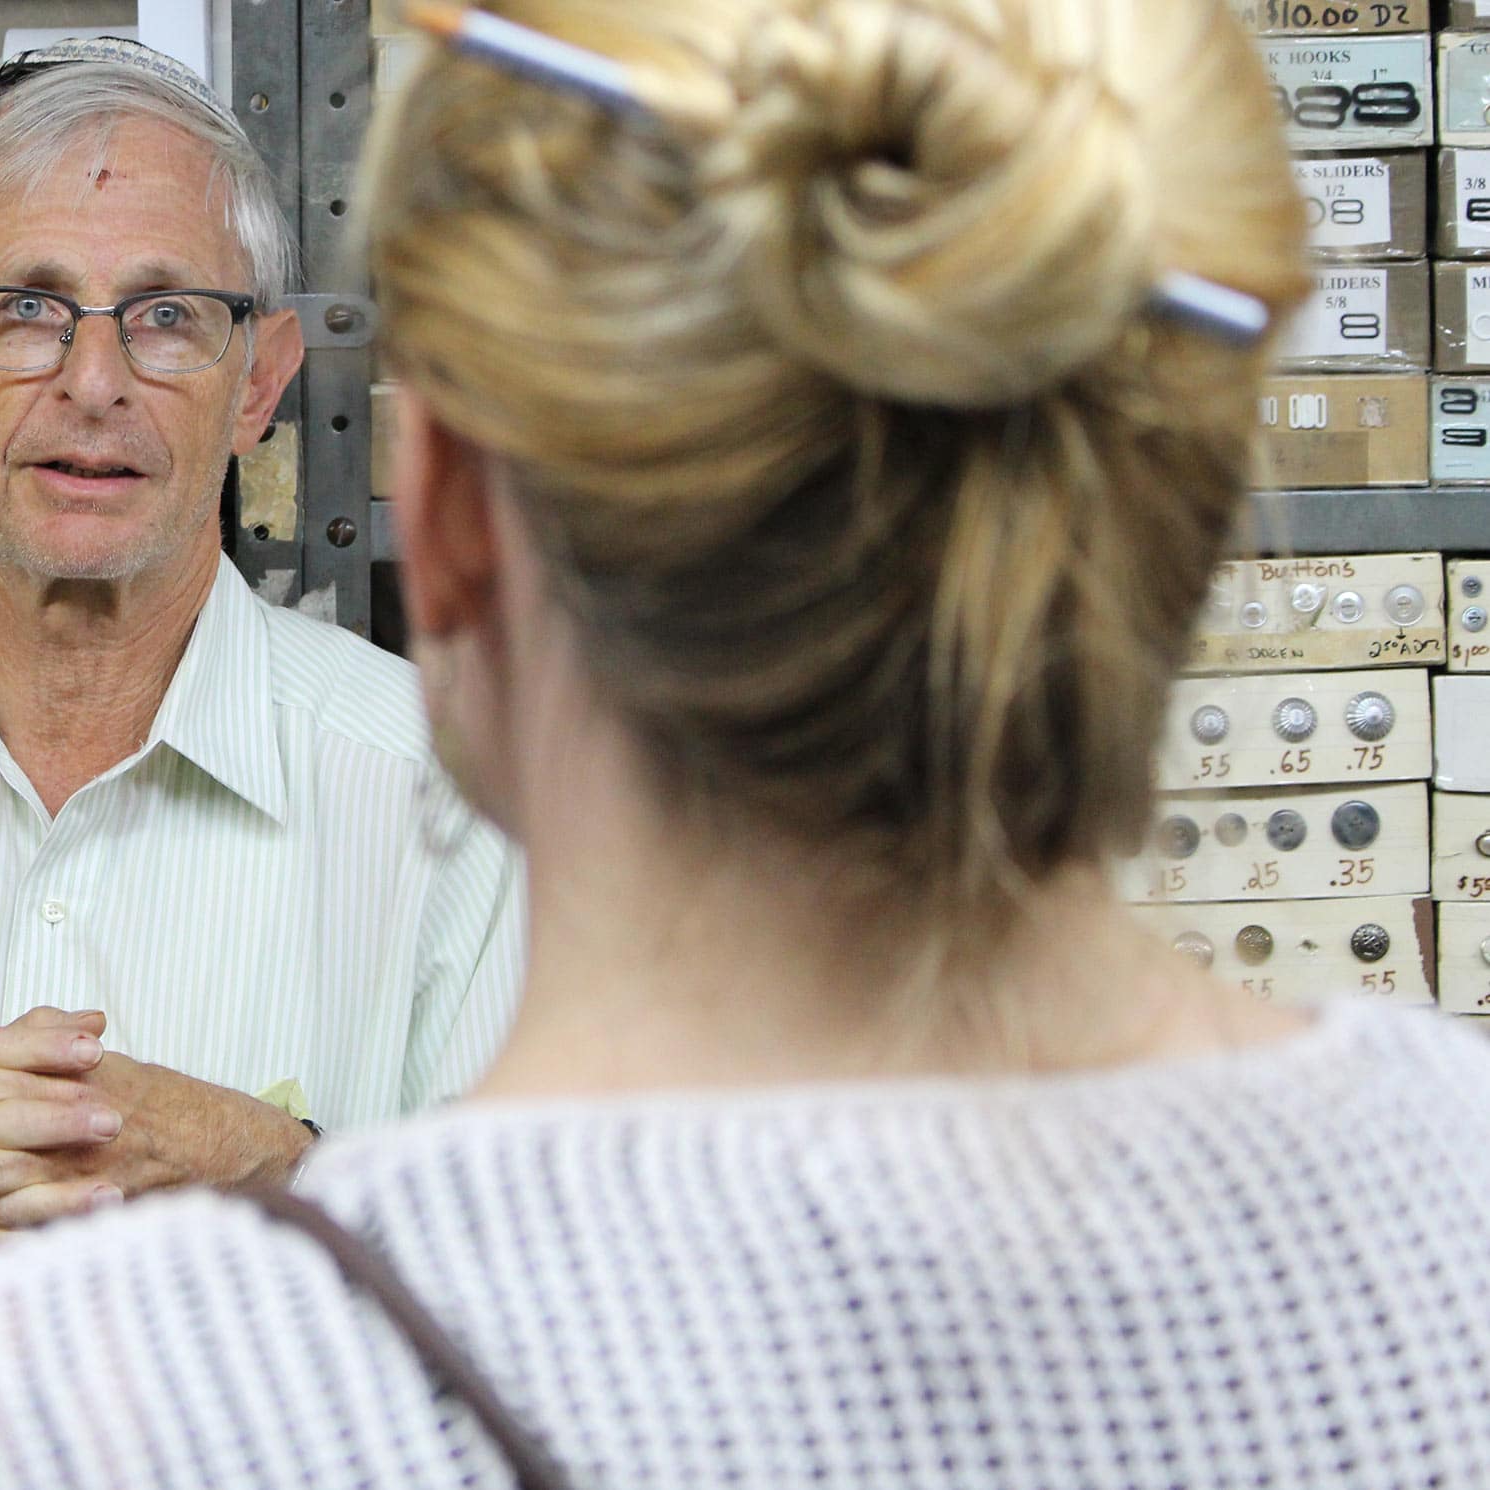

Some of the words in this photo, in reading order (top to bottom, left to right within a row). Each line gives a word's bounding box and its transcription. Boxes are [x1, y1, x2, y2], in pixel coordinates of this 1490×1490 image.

[1289, 49, 1352, 65] HOOKS
[1311, 69, 1333, 82] 3/4
[1313, 163, 1386, 178] SLIDERS
[1324, 184, 1346, 197] 1/2
[1464, 177, 1487, 191] 3/8
[1325, 295, 1348, 310] 5/8
[1192, 752, 1232, 781] .55
[1269, 748, 1313, 776] .65
[1345, 743, 1387, 772] .75
[1240, 860, 1281, 892] .25
[1329, 857, 1376, 888] .35
